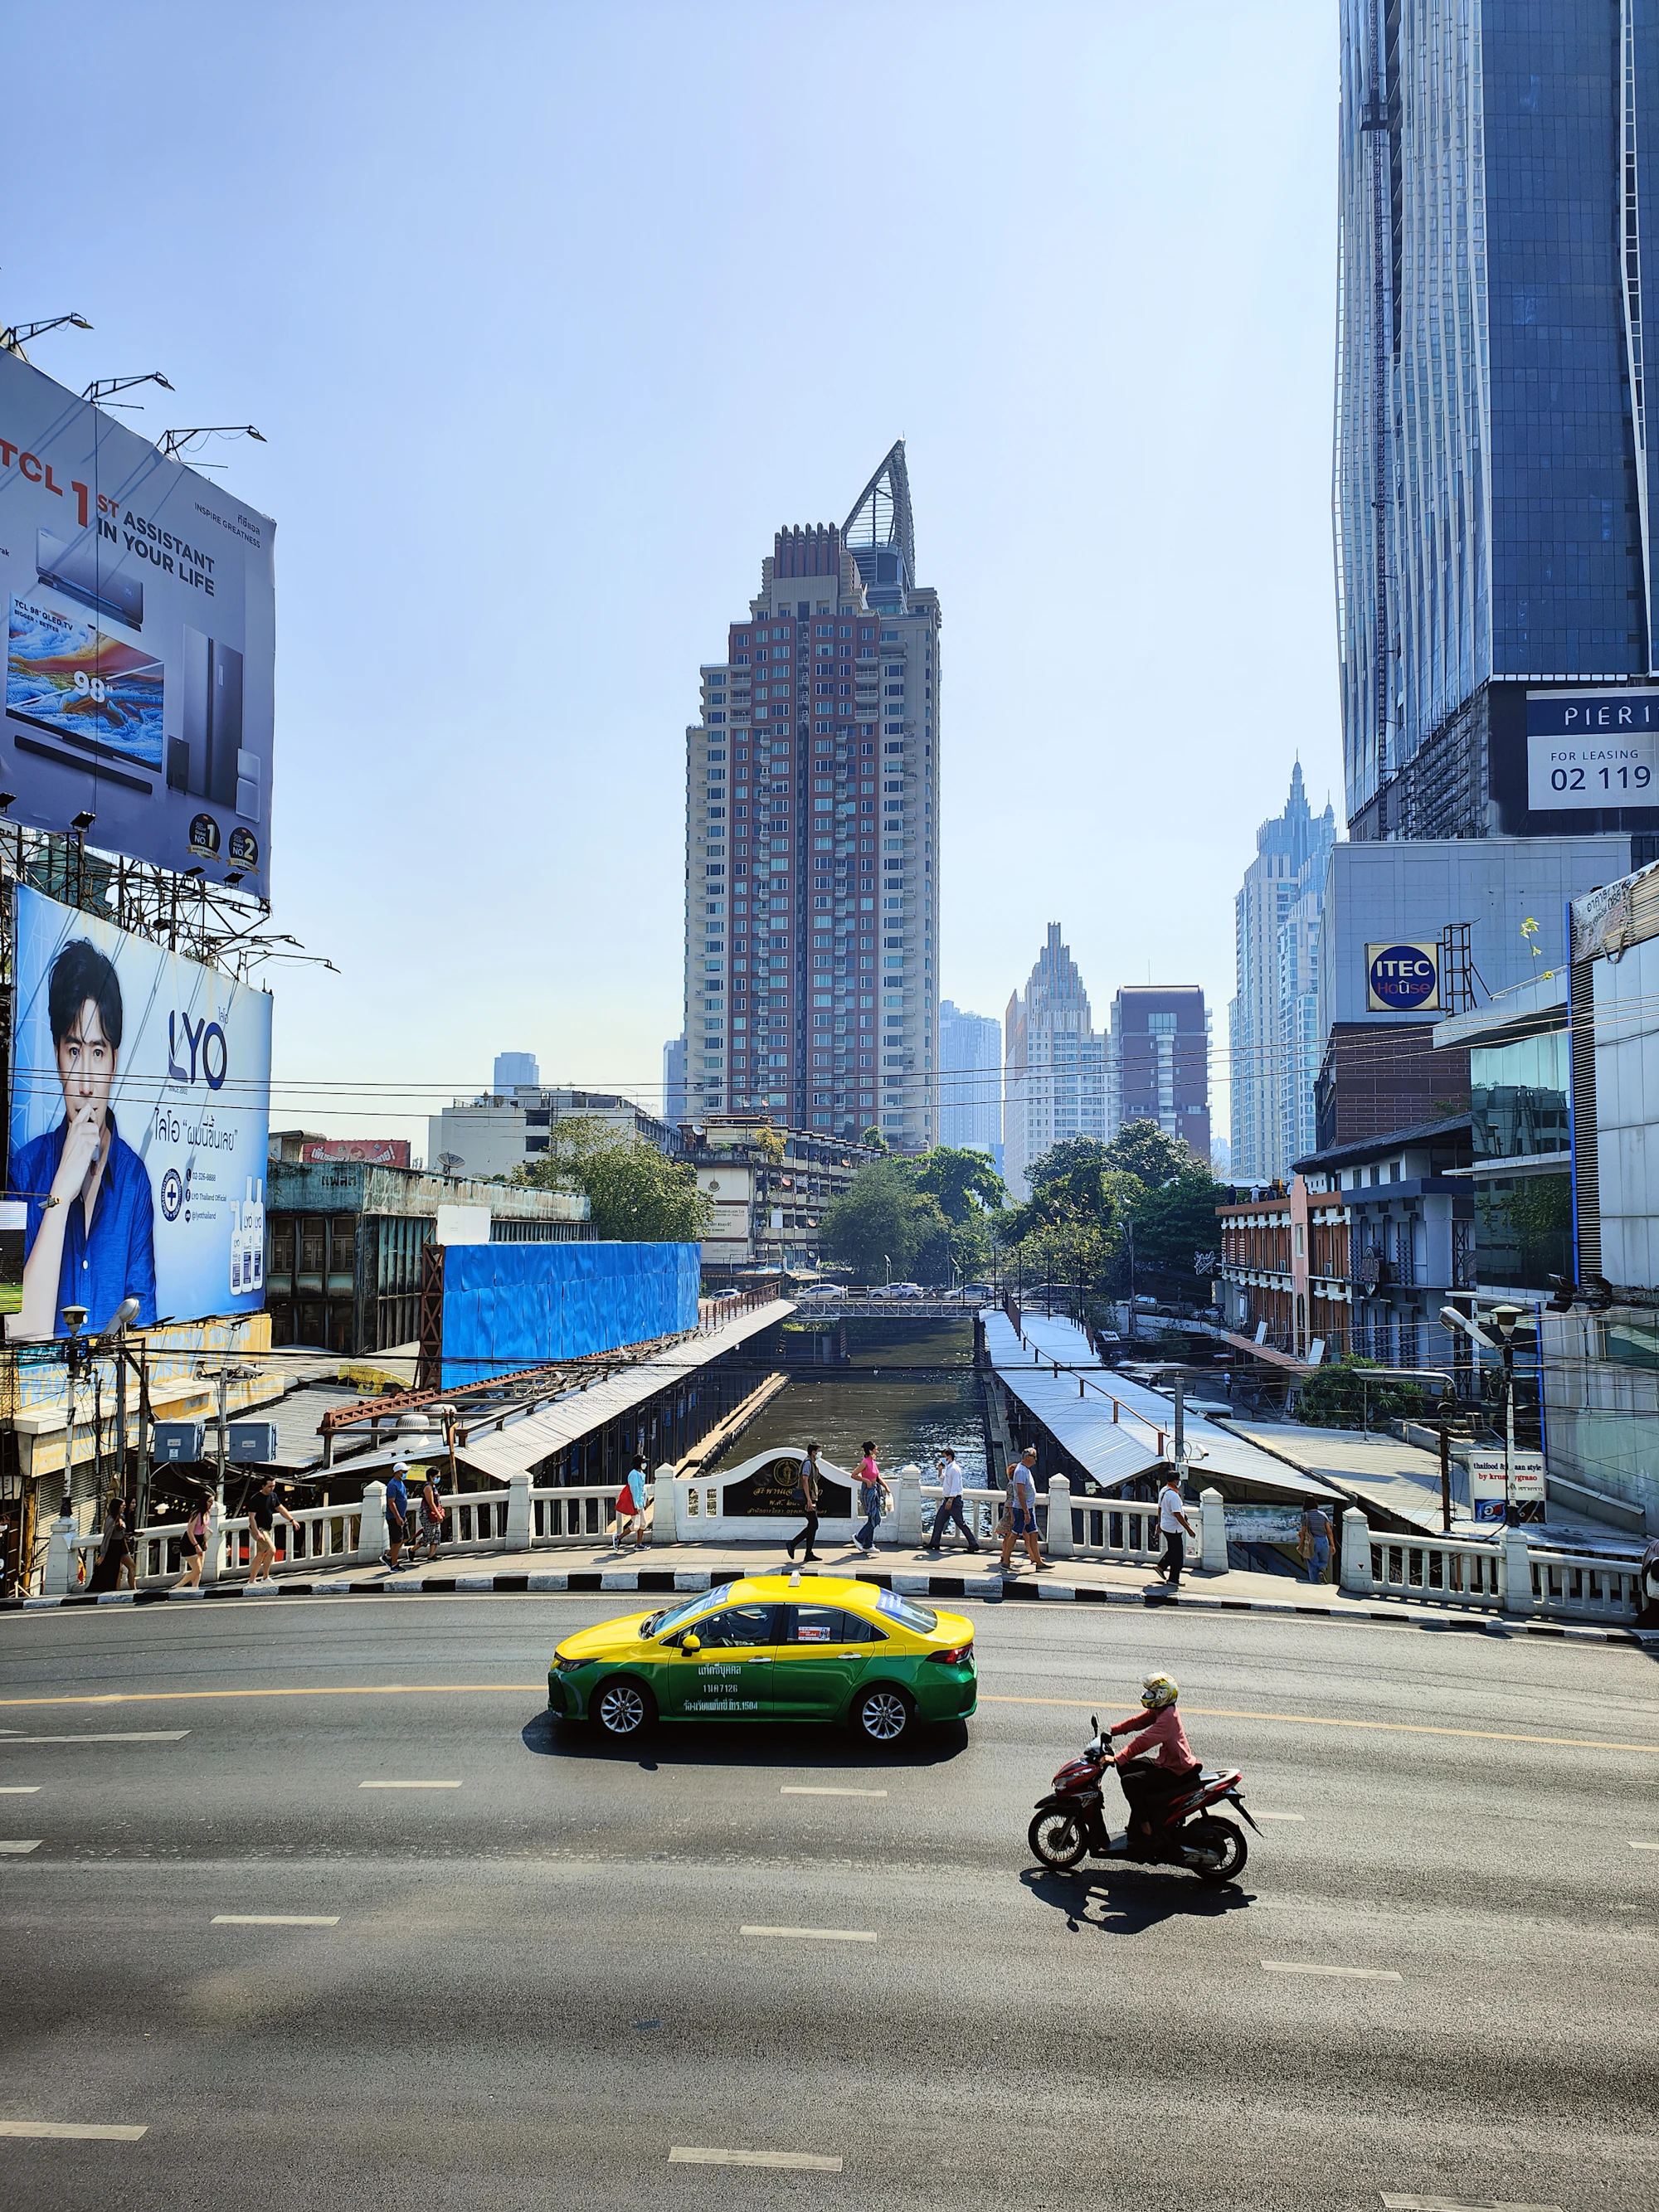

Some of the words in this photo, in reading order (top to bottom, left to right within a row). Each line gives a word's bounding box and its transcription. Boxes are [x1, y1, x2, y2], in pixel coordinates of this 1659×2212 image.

[0, 438, 63, 497] TCL
[124, 511, 215, 573] ASSISTANT
[194, 502, 222, 525] INSPIRE
[222, 520, 260, 548] GREATNESS
[98, 517, 118, 543] IN
[122, 531, 174, 574] YOUR
[179, 563, 215, 596] LIFE
[14, 599, 28, 611] TCL
[42, 612, 62, 625] QLED
[63, 621, 73, 630] TV
[1564, 705, 1632, 726] PIER
[1550, 751, 1576, 761] FOR
[1582, 749, 1639, 761] LEASING
[1550, 767, 1586, 791] 02
[1598, 766, 1651, 790] 119
[207, 824, 215, 848] 1
[244, 838, 255, 860] 2
[1377, 960, 1430, 977] ITEC
[168, 1009, 227, 1091] LYO
[154, 1106, 181, 1143] ไลโอ
[199, 1193, 215, 1201] Thailand
[244, 1216, 252, 1228] LYO
[1473, 1462, 1498, 1471] thaifood
[1527, 1464, 1542, 1472] style
